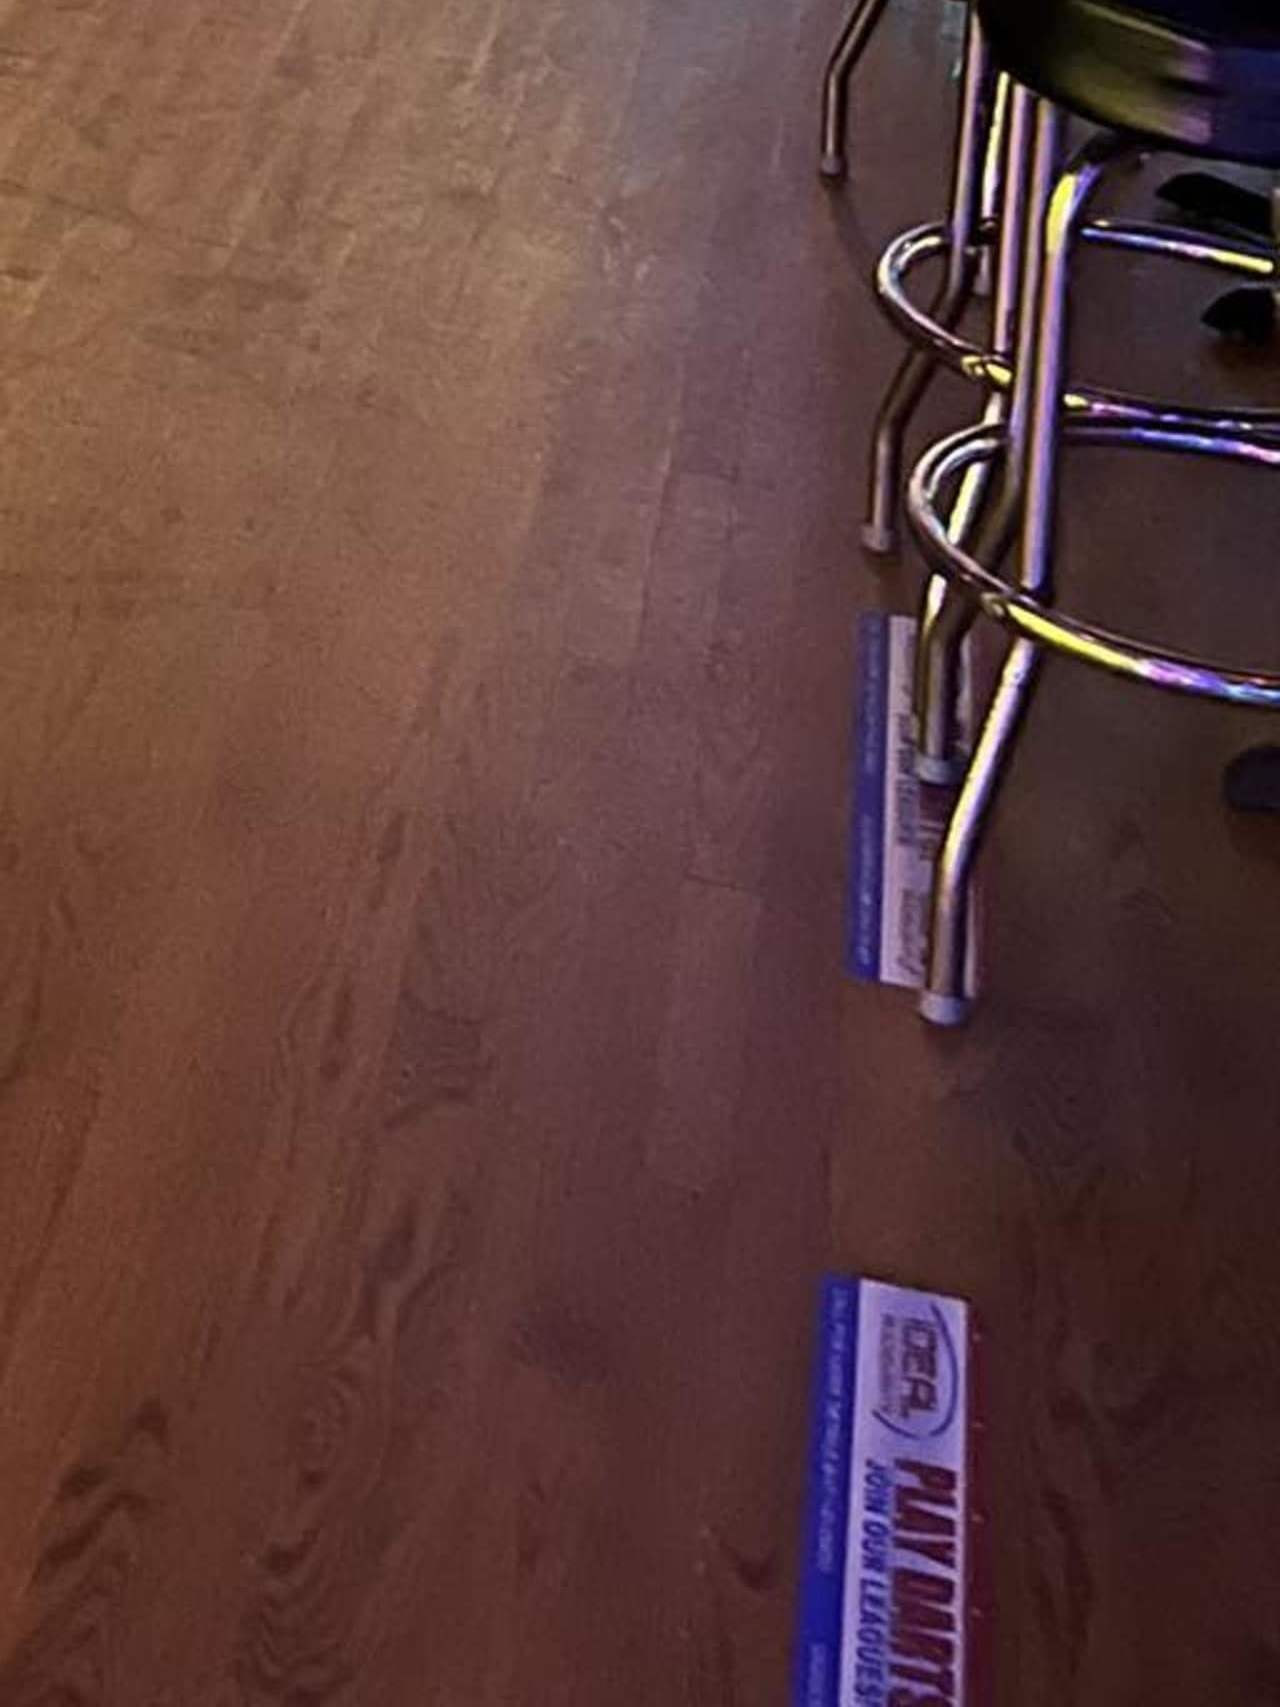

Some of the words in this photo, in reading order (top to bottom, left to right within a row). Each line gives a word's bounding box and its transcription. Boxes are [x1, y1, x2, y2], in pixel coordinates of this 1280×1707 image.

[863, 1458, 891, 1516] JOIN
[892, 1457, 958, 1571] PLAY
[860, 1518, 890, 1573] OUR
